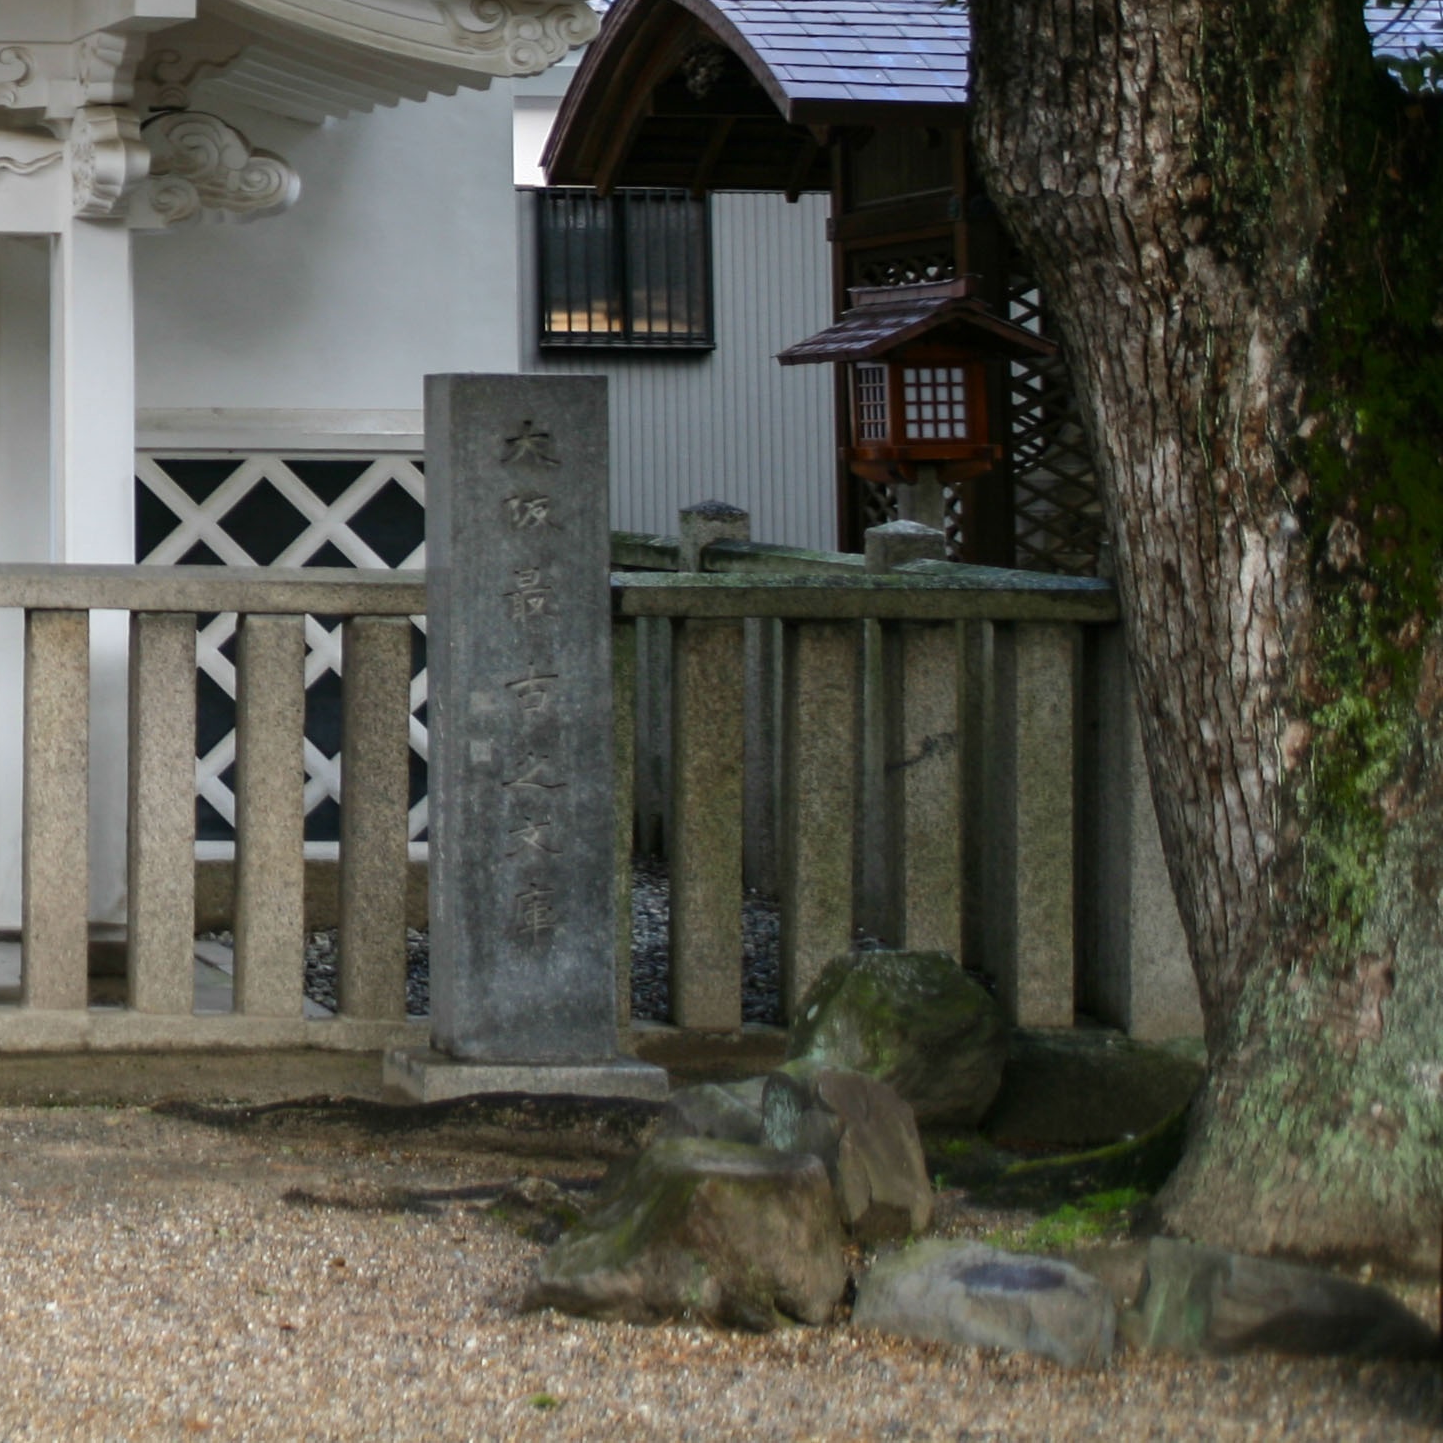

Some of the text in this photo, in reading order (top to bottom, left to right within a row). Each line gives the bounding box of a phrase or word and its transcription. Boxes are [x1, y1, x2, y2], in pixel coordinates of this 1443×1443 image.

[500, 418, 568, 946] 大阪最古之文庫
